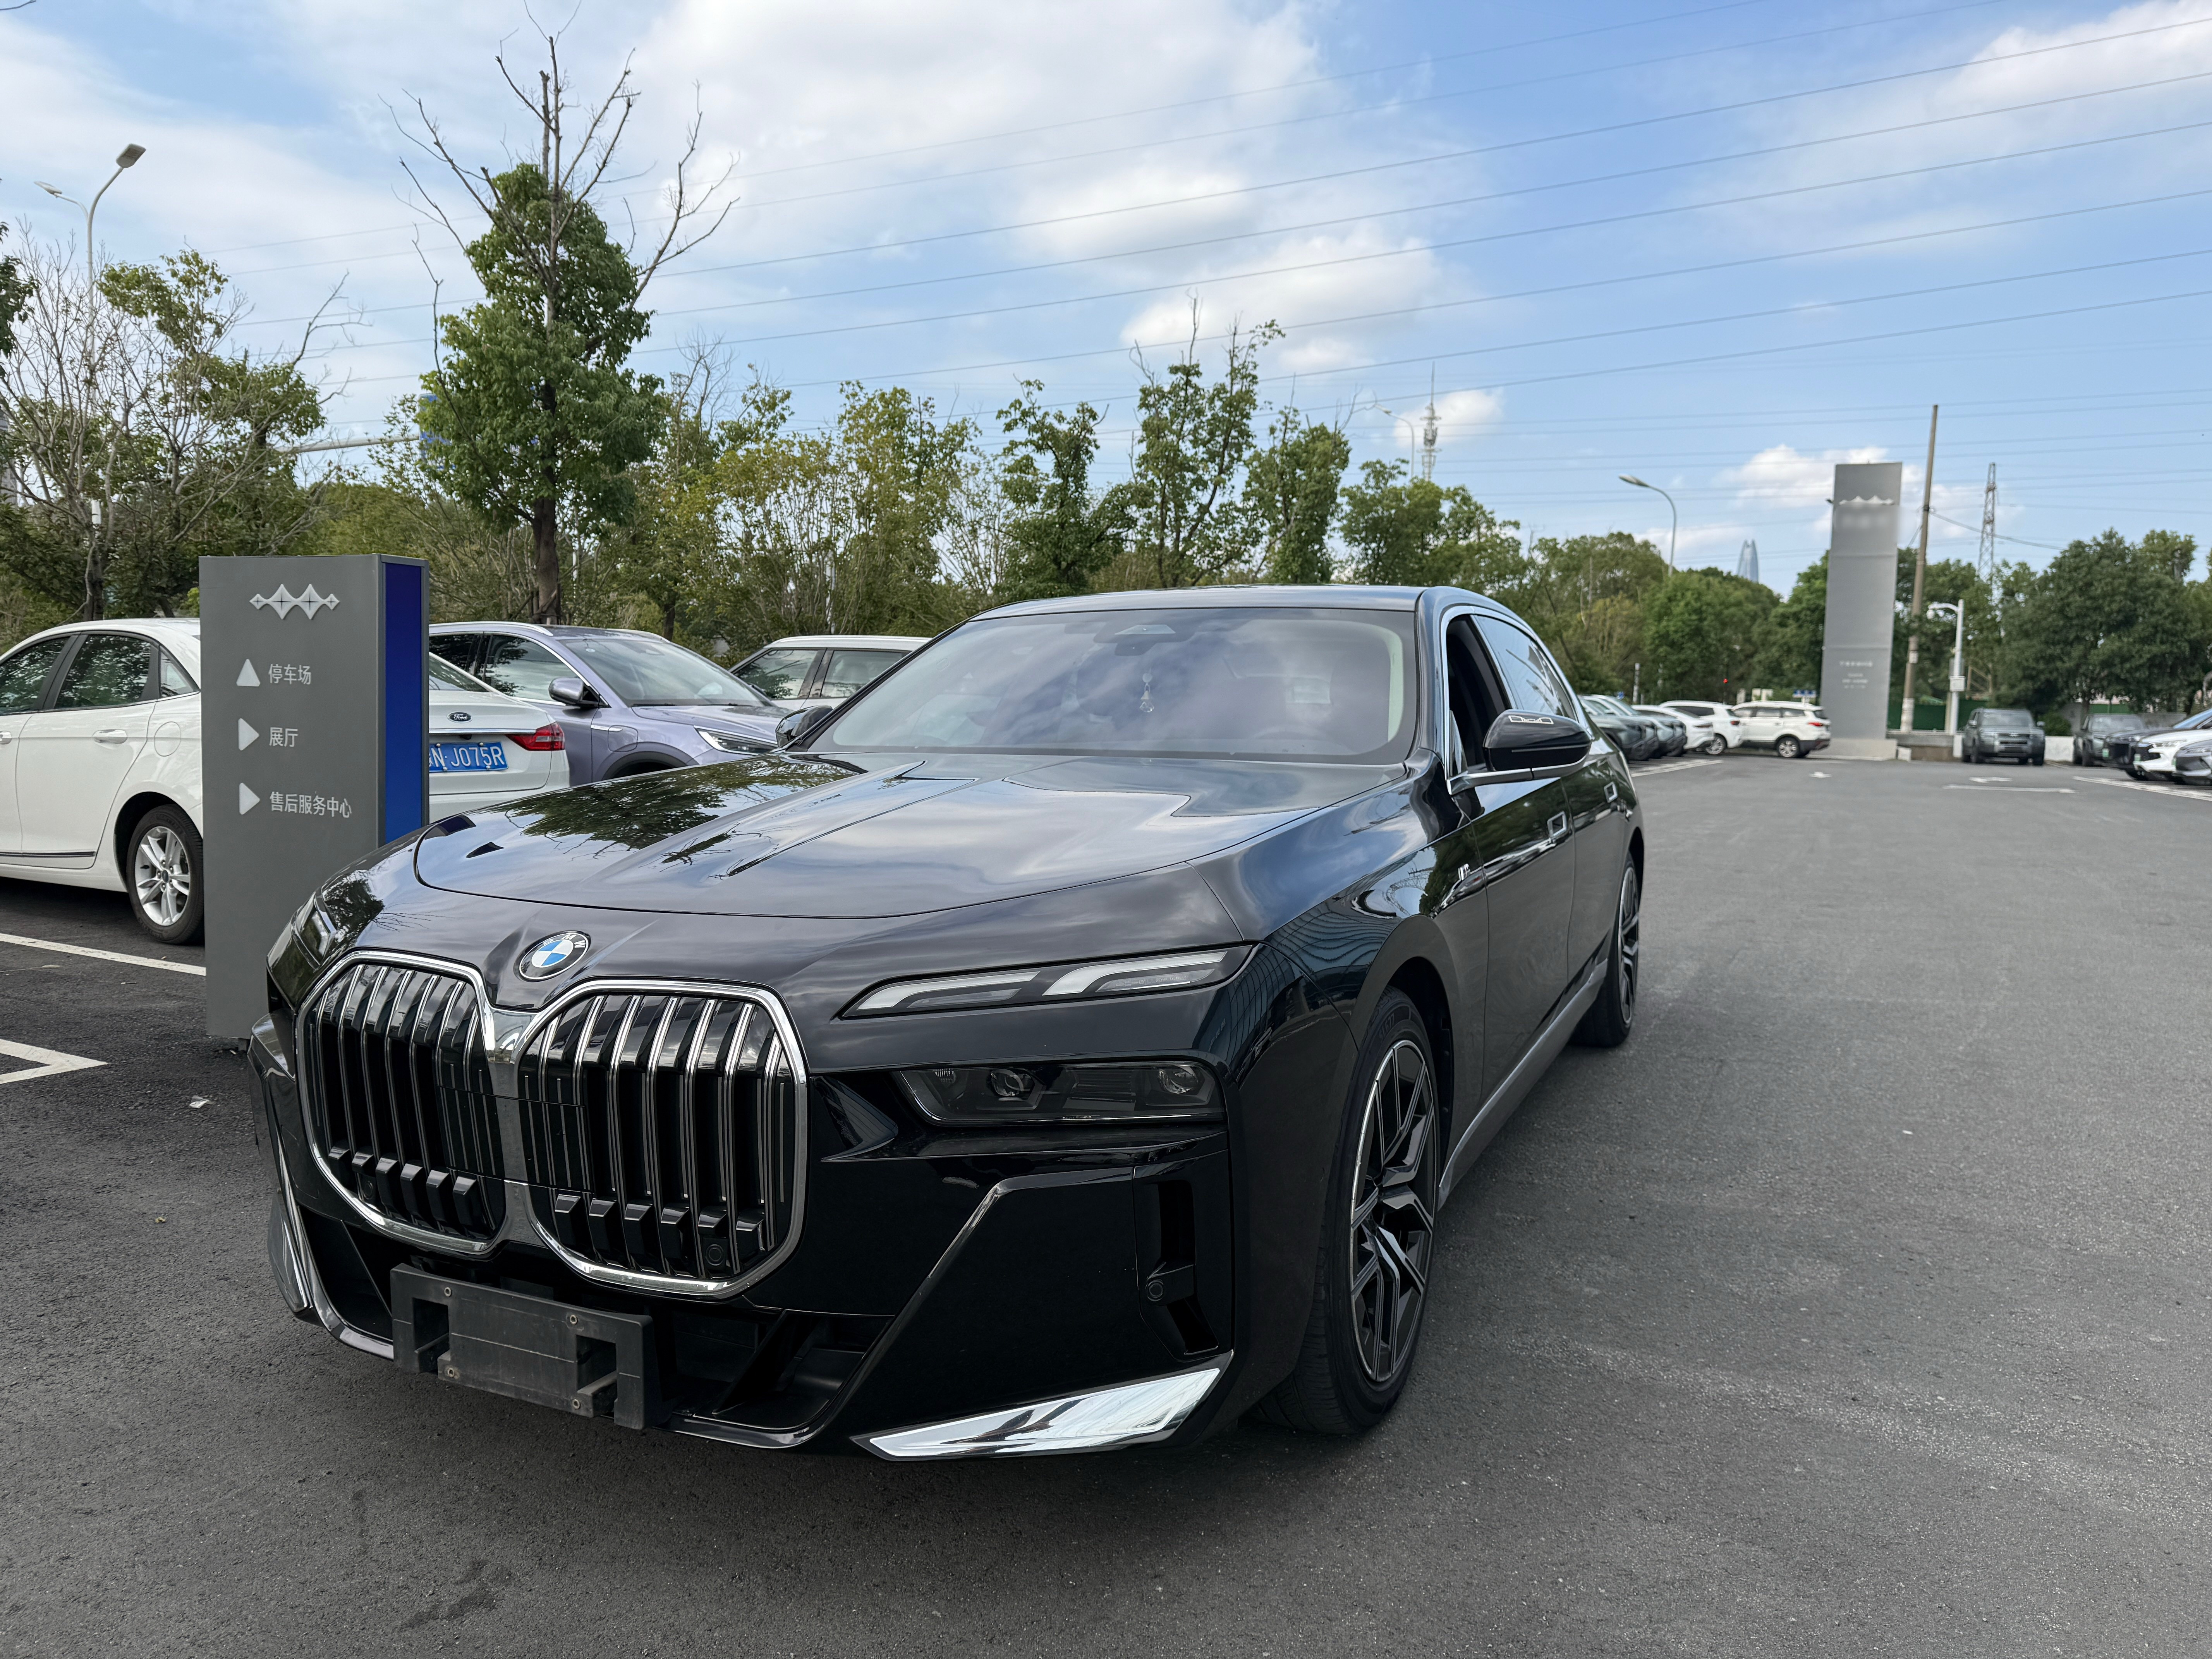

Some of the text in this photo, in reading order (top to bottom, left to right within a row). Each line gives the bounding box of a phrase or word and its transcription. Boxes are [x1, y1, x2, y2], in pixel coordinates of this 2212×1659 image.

[268, 664, 311, 685] 停车场
[269, 727, 298, 747] 展厅
[269, 791, 352, 818] 售后服务中心
[543, 934, 586, 948] BMW
